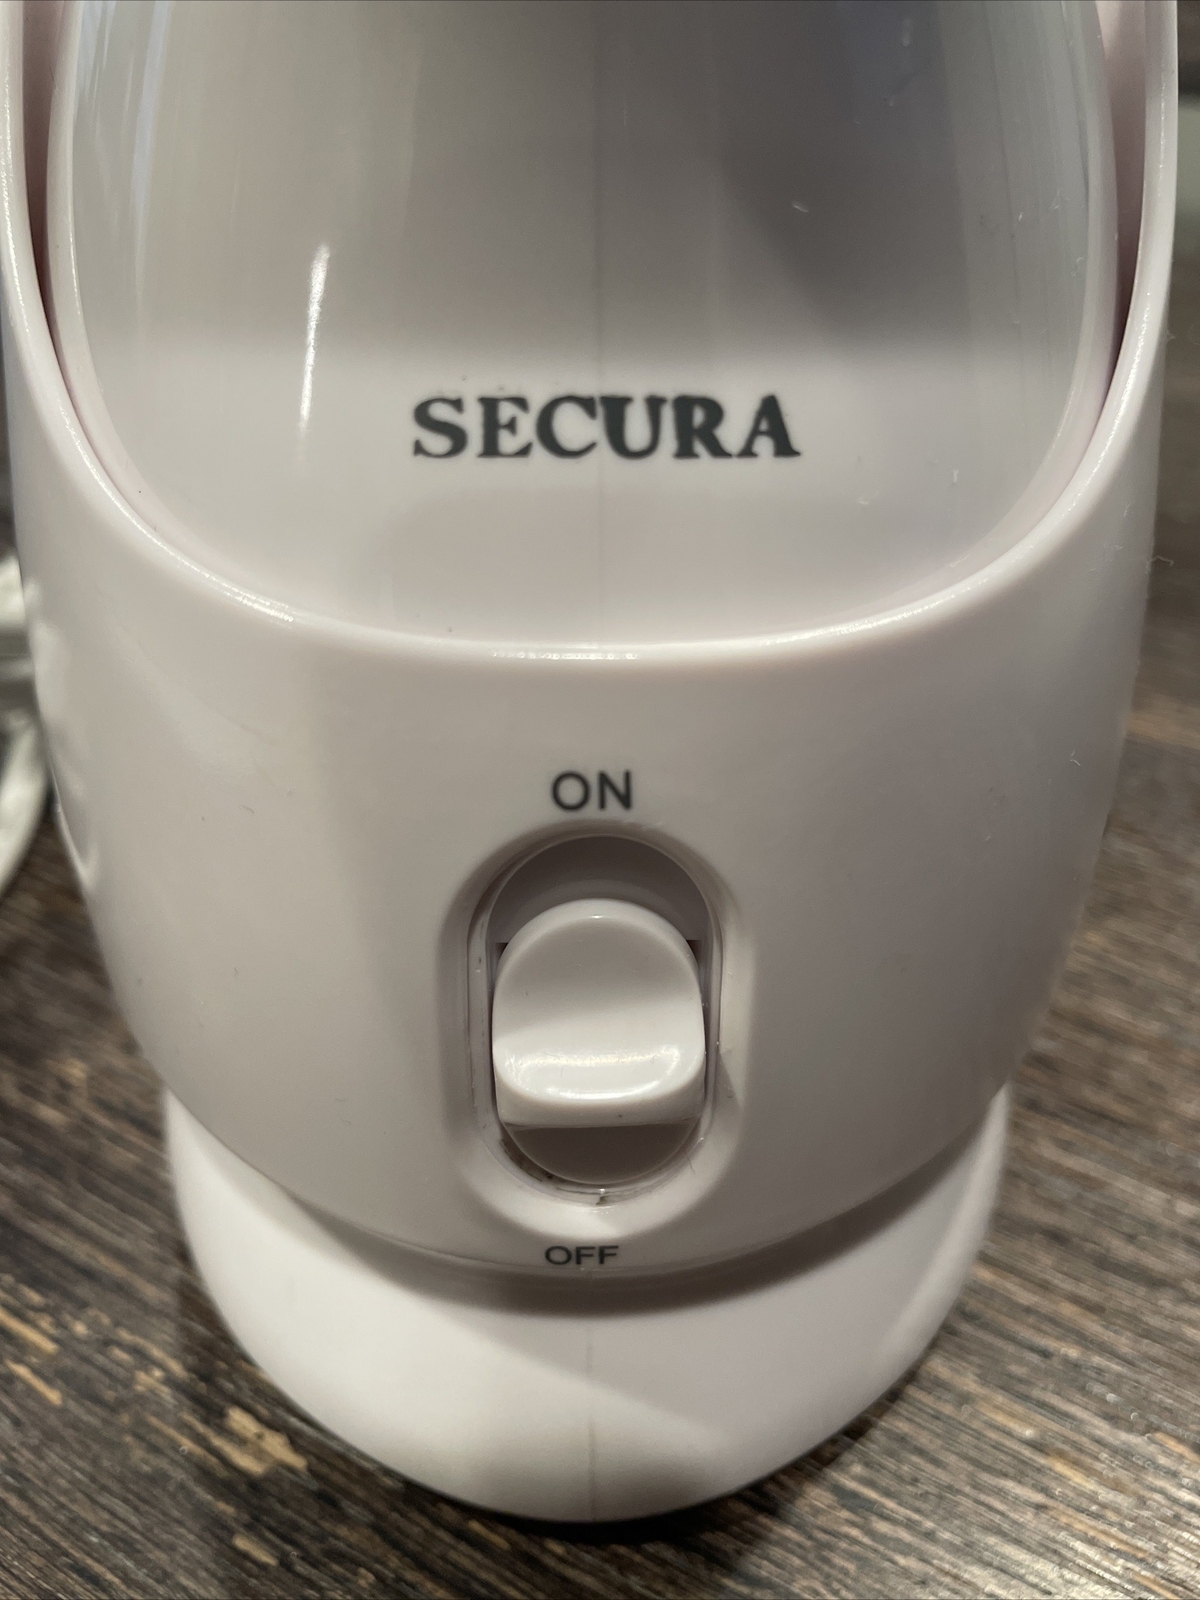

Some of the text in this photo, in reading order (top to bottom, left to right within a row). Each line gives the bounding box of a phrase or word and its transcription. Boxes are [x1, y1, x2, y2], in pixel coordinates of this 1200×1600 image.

[412, 393, 802, 461] SECURA
[550, 769, 634, 812] ON
[544, 1245, 620, 1266] OFF
